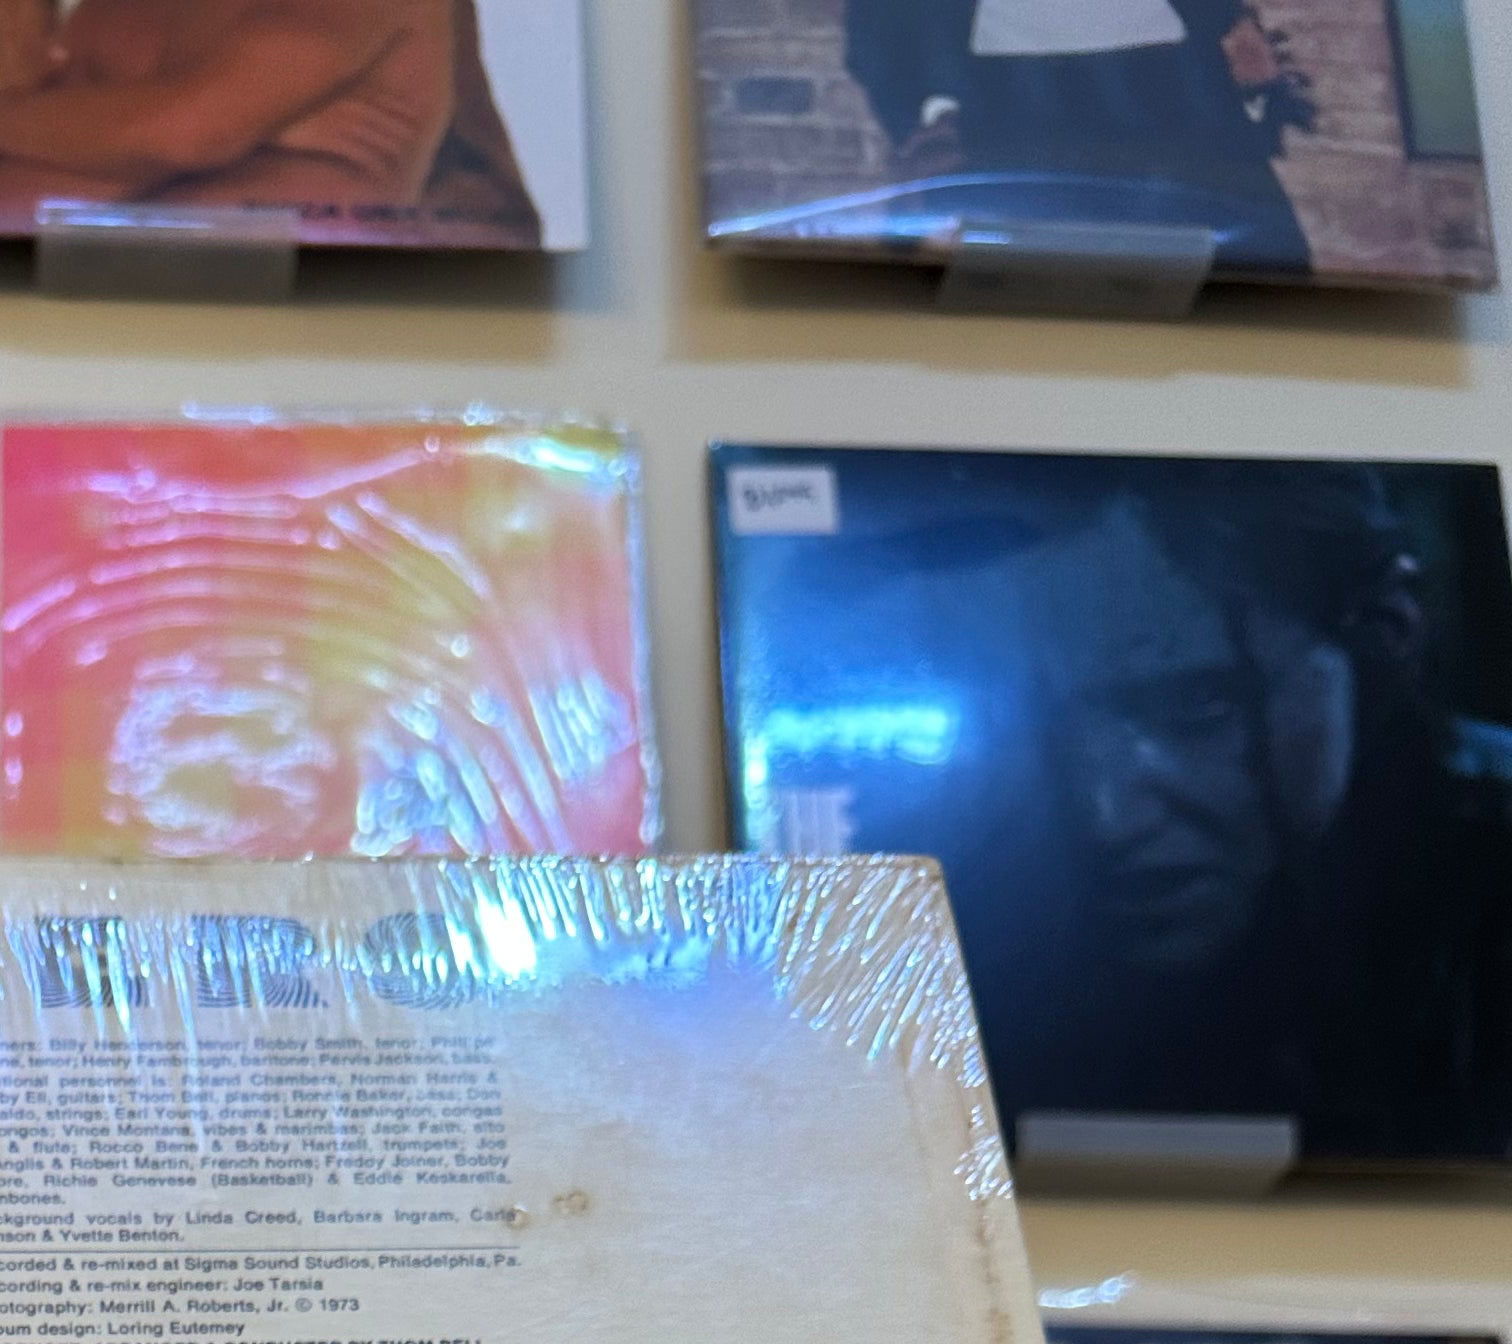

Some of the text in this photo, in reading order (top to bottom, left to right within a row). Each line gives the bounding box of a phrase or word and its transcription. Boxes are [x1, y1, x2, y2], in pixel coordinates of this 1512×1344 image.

[63, 1258, 75, 1271] &
[81, 1258, 157, 1271] re-mixed
[163, 1258, 179, 1271] at
[184, 1257, 238, 1273] Sigma
[244, 1256, 299, 1270] Sound
[305, 1256, 375, 1271] Studios,
[378, 1255, 490, 1271] Philadelphia,
[494, 1254, 522, 1267] Pa.
[69, 1280, 81, 1293] &
[87, 1280, 141, 1292] re-mix
[146, 1279, 228, 1294] engineer:
[233, 1279, 264, 1292] Joe
[270, 1277, 324, 1291] Tarsia
[100, 1300, 155, 1313] Merrill
[163, 1300, 180, 1313] A.
[187, 1299, 260, 1314] Roberts,
[267, 1299, 289, 1313] Jr.
[320, 1298, 360, 1311] 1973
[38, 1322, 101, 1337] design:
[107, 1322, 163, 1337] Loring
[170, 1322, 245, 1336] Eutemey
